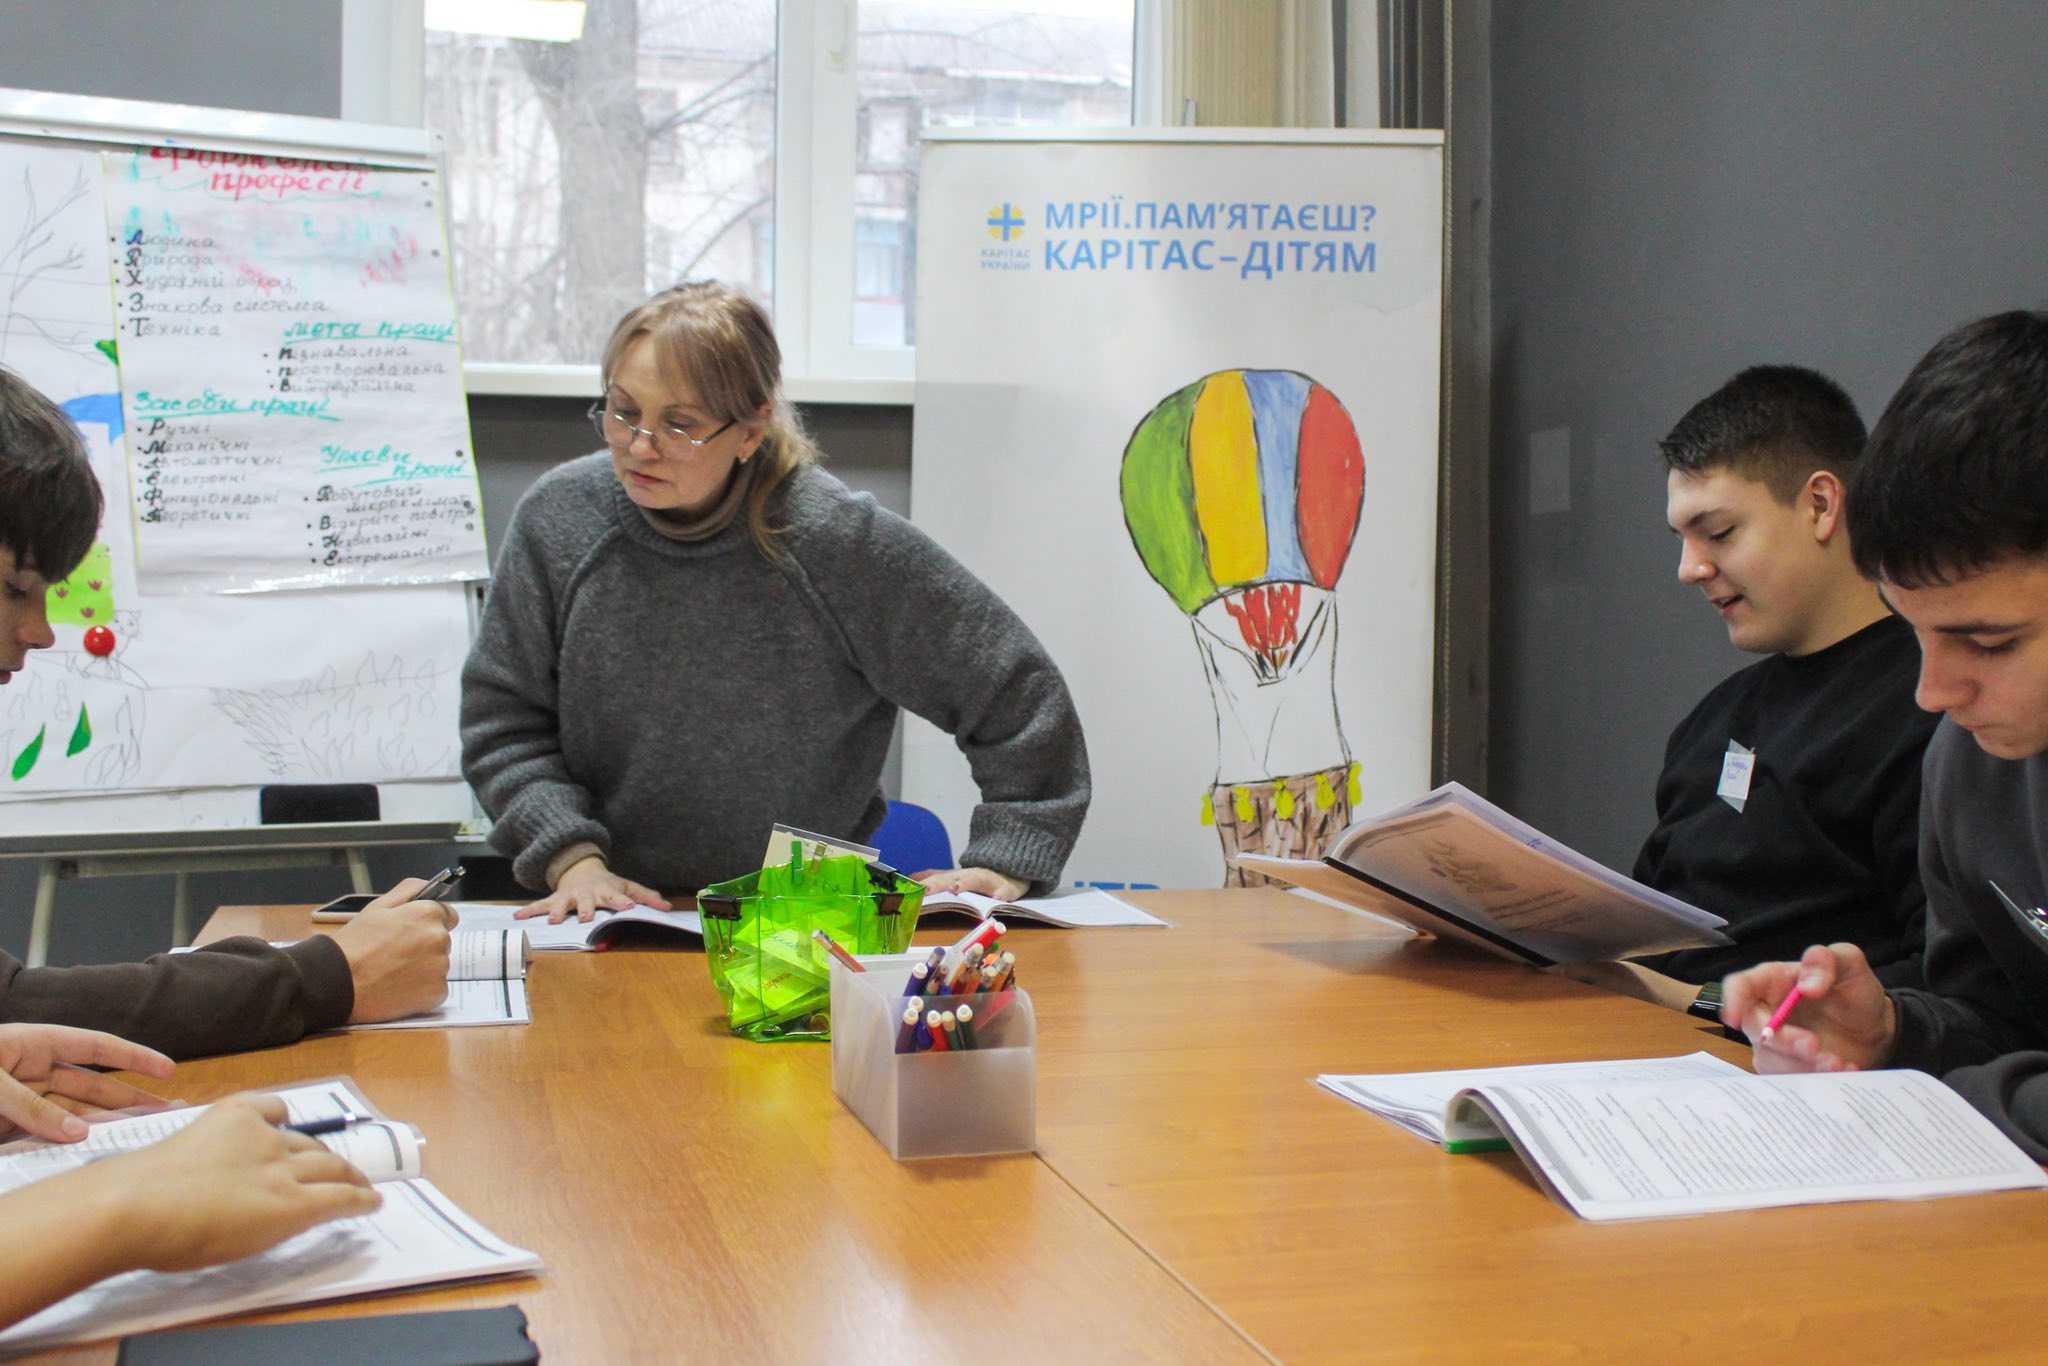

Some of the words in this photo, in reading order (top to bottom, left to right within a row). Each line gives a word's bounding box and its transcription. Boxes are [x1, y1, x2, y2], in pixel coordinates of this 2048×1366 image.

[211, 170, 368, 201] професії
[126, 229, 217, 250] Людина
[981, 248, 1032, 260] КАРІТАС
[981, 260, 1032, 271] УКРАЇНИ
[129, 293, 223, 313] Знакова
[233, 301, 329, 313] система
[129, 317, 221, 338] Техніка
[133, 388, 239, 412] Засоби
[149, 418, 210, 436] Ручні
[320, 444, 411, 465] Умови
